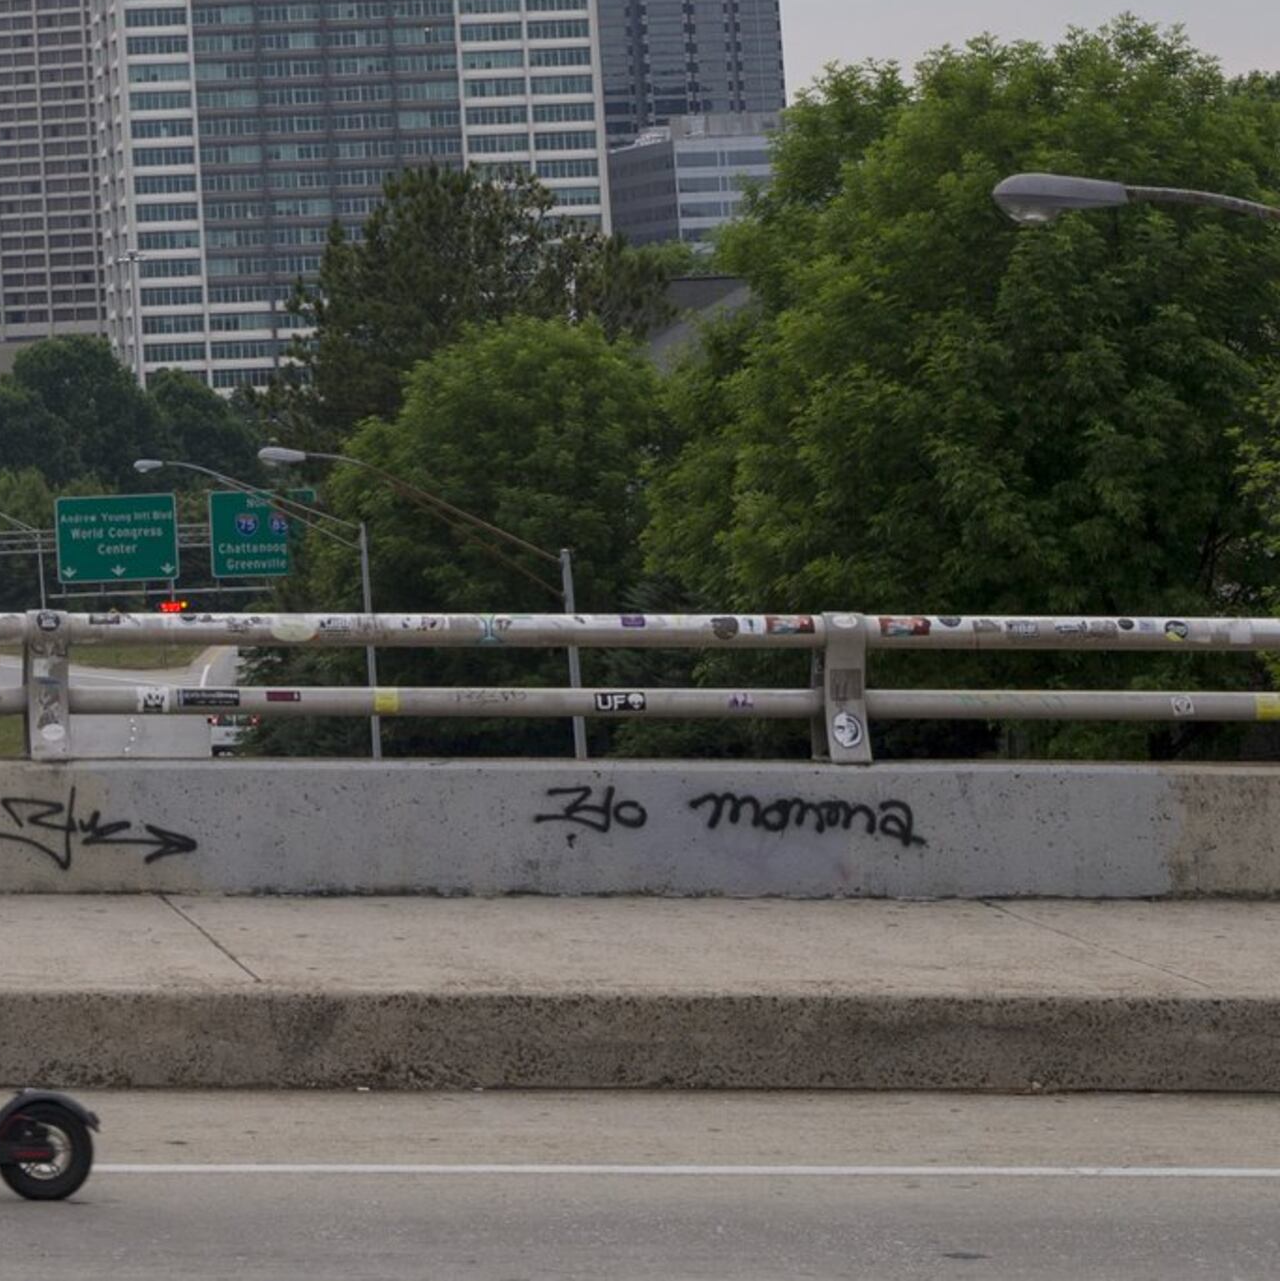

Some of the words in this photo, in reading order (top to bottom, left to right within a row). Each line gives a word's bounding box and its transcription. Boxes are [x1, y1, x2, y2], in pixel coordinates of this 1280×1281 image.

[60, 513, 97, 523] Andrew
[100, 511, 132, 523] Young
[239, 520, 255, 531] 75
[70, 527, 104, 539] World
[107, 526, 164, 540] Congress
[97, 543, 138, 555] Center
[218, 543, 287, 555] Chattanoog
